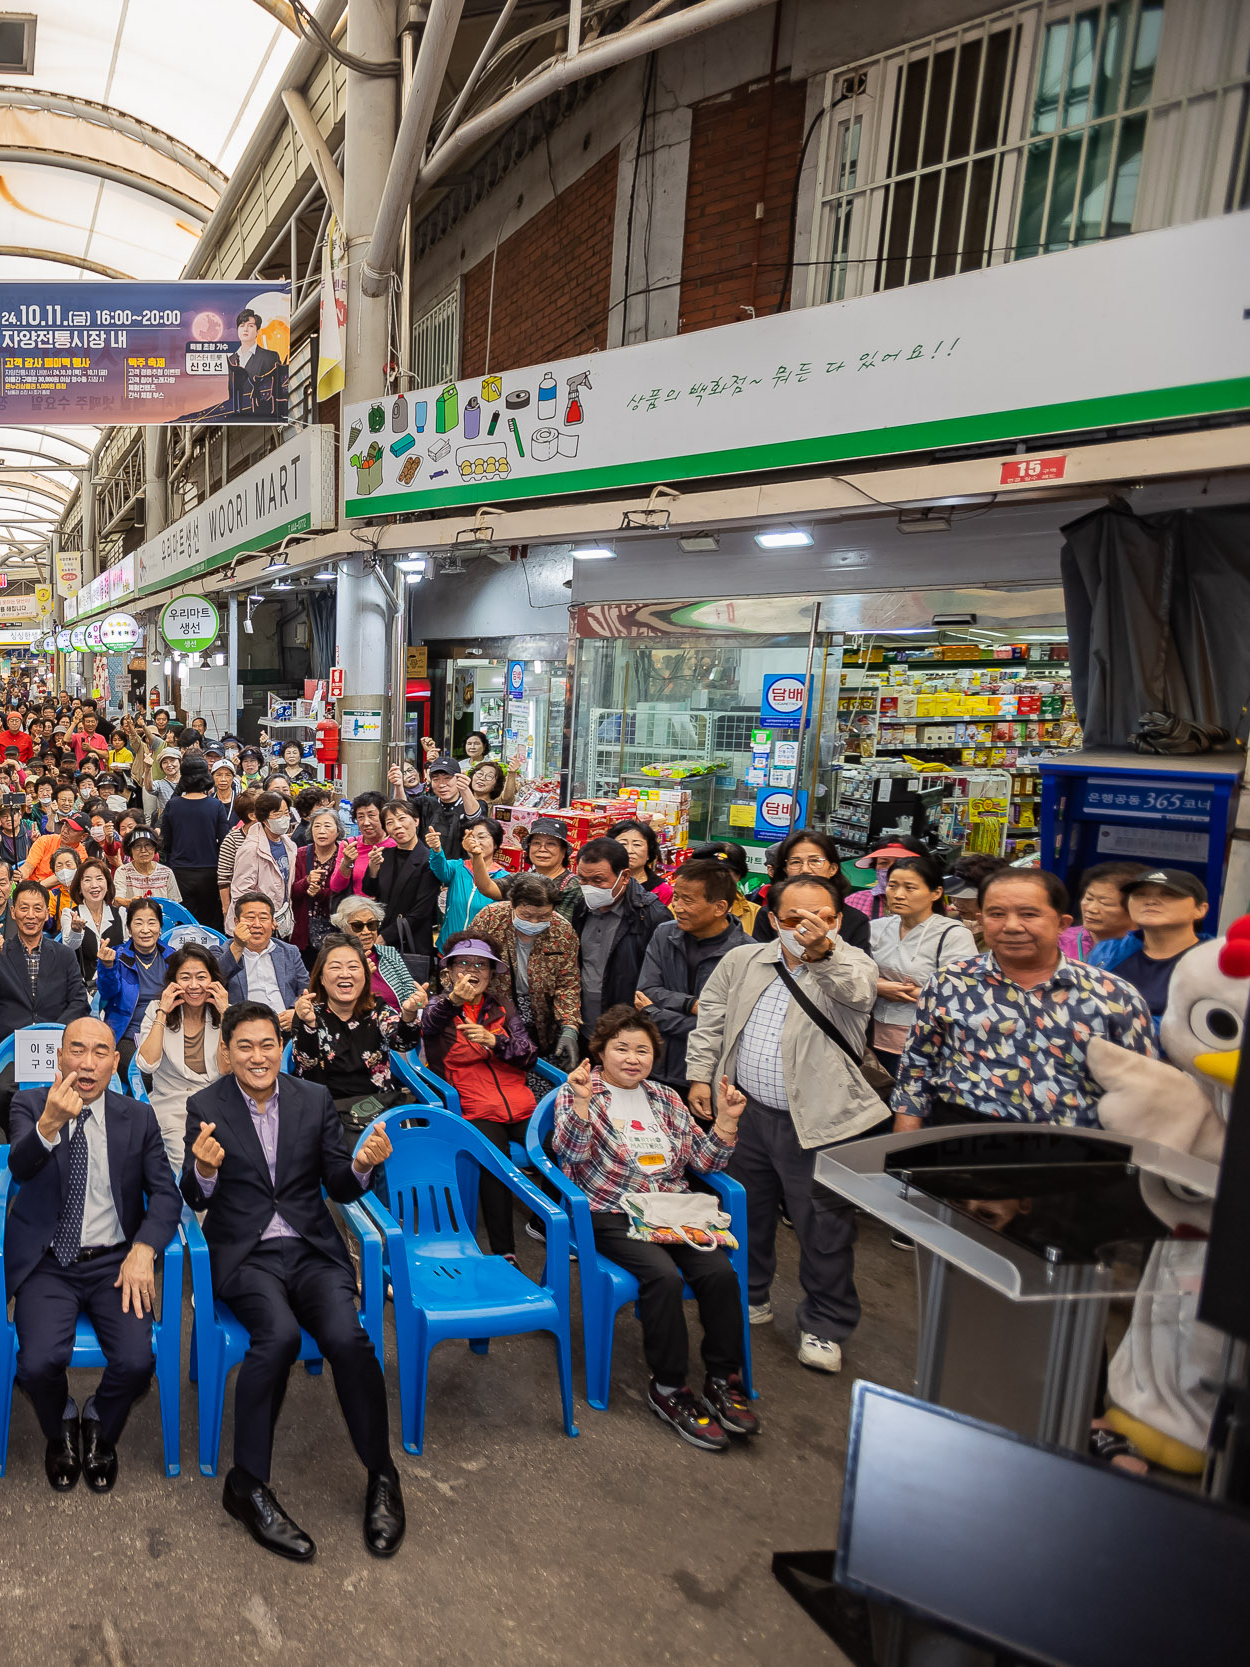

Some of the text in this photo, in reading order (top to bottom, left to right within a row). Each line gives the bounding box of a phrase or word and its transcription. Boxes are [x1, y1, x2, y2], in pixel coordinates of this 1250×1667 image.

[1, 305, 181, 326] 24.10.11.(금) 16:00~20:00
[2, 330, 127, 349] 자양전통시장 내
[4, 357, 23, 368] 고객
[627, 388, 681, 412] 상품의
[772, 362, 813, 389] 뭐든
[825, 360, 846, 374] 다
[1017, 460, 1041, 477] 15
[208, 454, 301, 543] WOORI MART
[168, 607, 212, 620] 우리마트
[179, 622, 202, 634] 생선
[183, 640, 197, 648] 생선
[771, 687, 804, 702] 담배
[1087, 792, 1211, 811] 은행공동 365 코너
